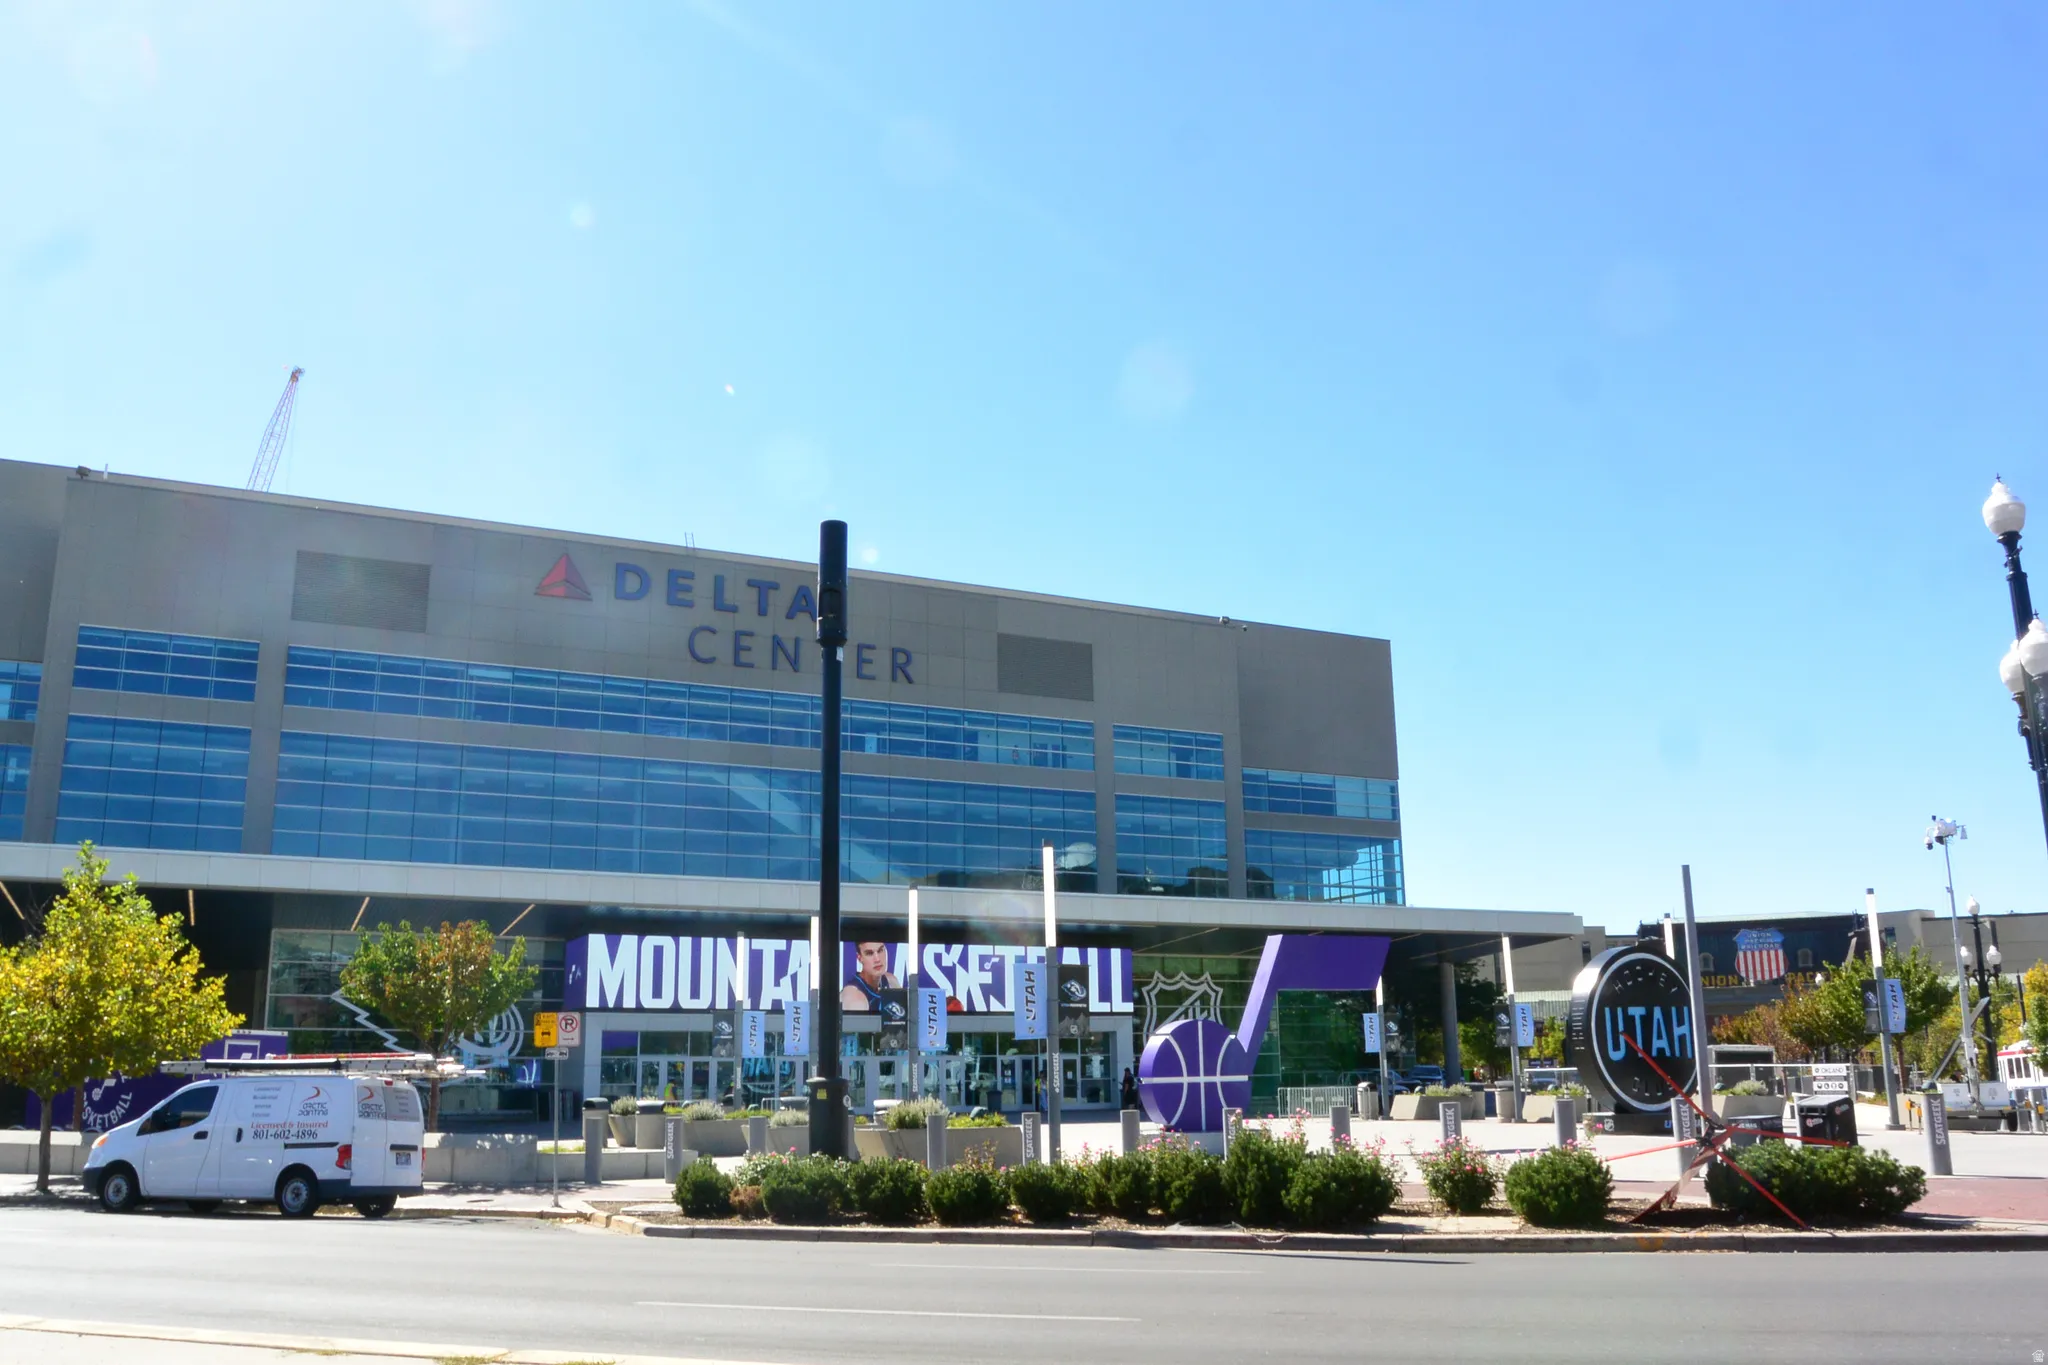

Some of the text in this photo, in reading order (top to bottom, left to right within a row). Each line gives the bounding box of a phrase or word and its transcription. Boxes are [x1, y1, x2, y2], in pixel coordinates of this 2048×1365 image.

[614, 562, 818, 622] DELTA
[688, 625, 914, 684] CENER
[1025, 970, 1036, 1021] UTAH
[1701, 975, 1739, 987] NION
[793, 1006, 802, 1043] UTAH
[928, 994, 937, 1036] UTAH
[1604, 1006, 1693, 1062] UTAH
[251, 1121, 287, 1129] Licensed
[296, 1120, 328, 1129] Insured
[252, 1129, 318, 1140] 801-602-4896
[667, 1121, 675, 1160] SEATGEEK
[1026, 1117, 1034, 1159] SEATGEEK
[1931, 1099, 1945, 1145] SEATGEEK
